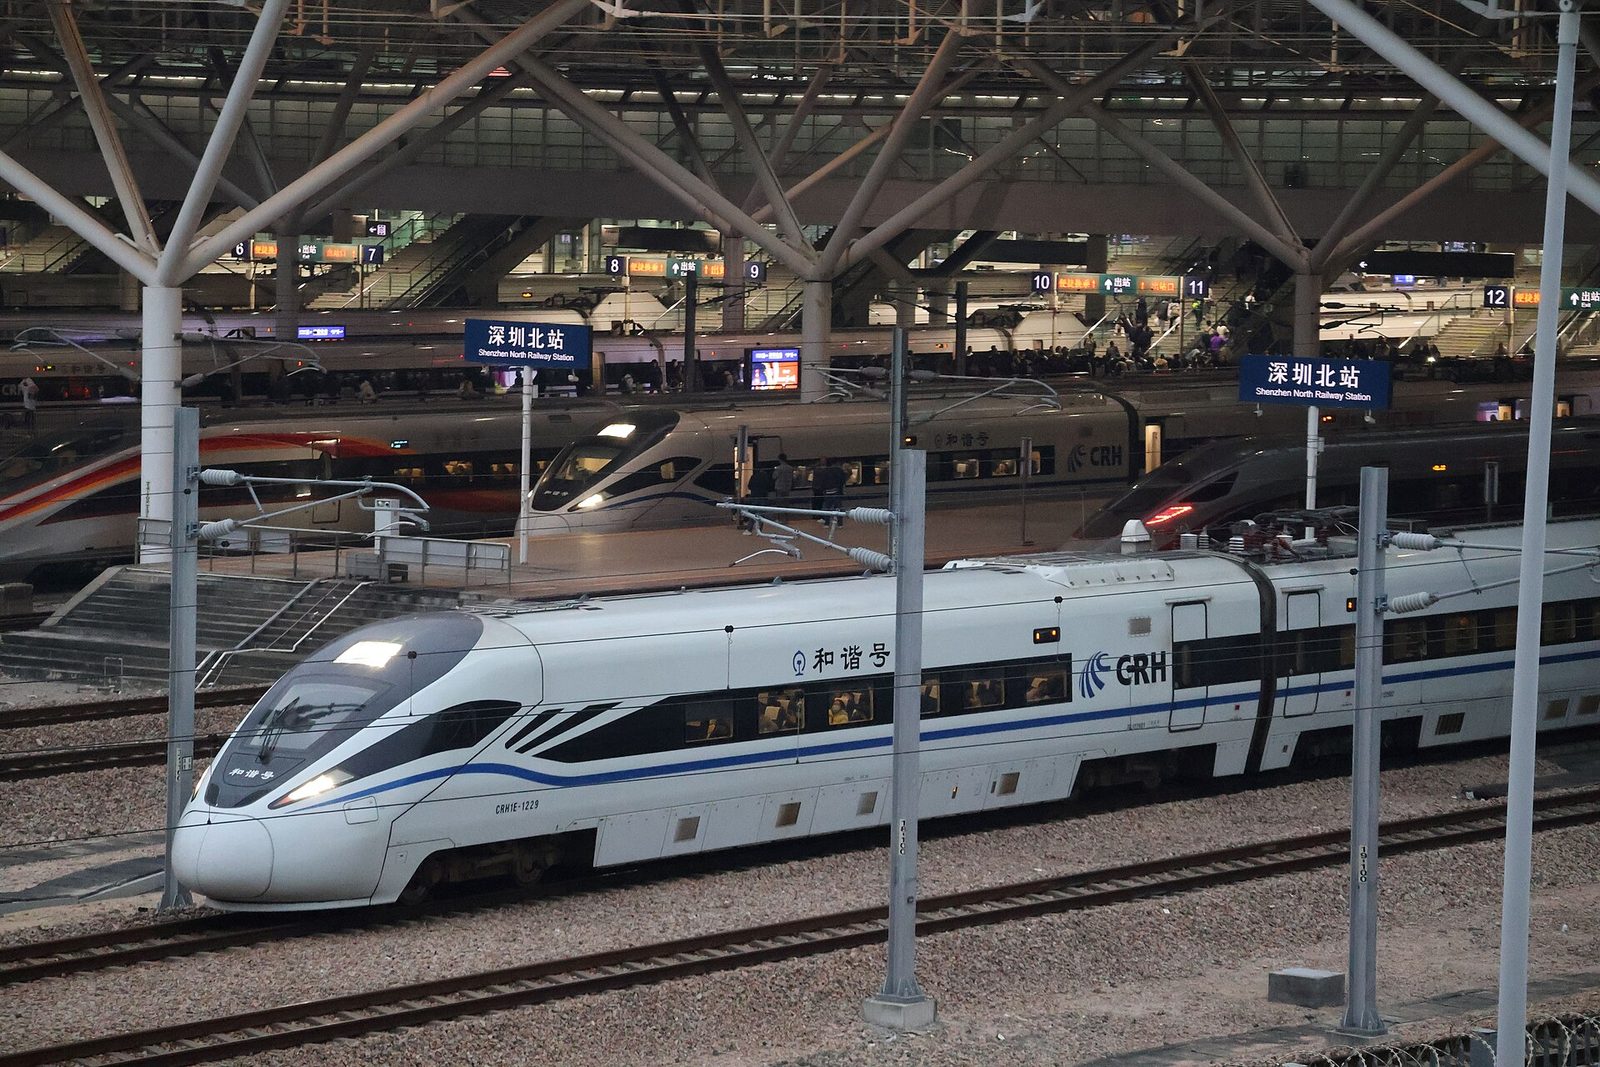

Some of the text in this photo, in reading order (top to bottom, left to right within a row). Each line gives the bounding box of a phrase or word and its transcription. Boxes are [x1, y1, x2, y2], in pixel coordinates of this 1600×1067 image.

[235, 242, 244, 256] 6
[302, 244, 317, 255] 出站
[368, 248, 377, 261] 7
[610, 258, 619, 273] 8
[680, 261, 696, 271] 出站
[750, 264, 759, 279] 9
[1033, 275, 1050, 290] 10
[1113, 277, 1131, 287] 出站
[1189, 280, 1203, 295] 11
[1486, 289, 1505, 305] 12
[1581, 291, 1600, 302] 出站
[488, 325, 565, 350] 深圳北站
[478, 348, 575, 362] Shenzhen North Railway Station
[1268, 361, 1361, 389] 深圳北站
[1255, 387, 1372, 402] Shenzhen North Railway Station
[945, 431, 990, 447] 和谐号
[1090, 445, 1122, 467] CRH
[812, 643, 891, 673] 和谐号
[1116, 651, 1167, 686] CRH
[228, 767, 275, 780] 和谐号
[495, 799, 540, 815] CRH1E-1229
